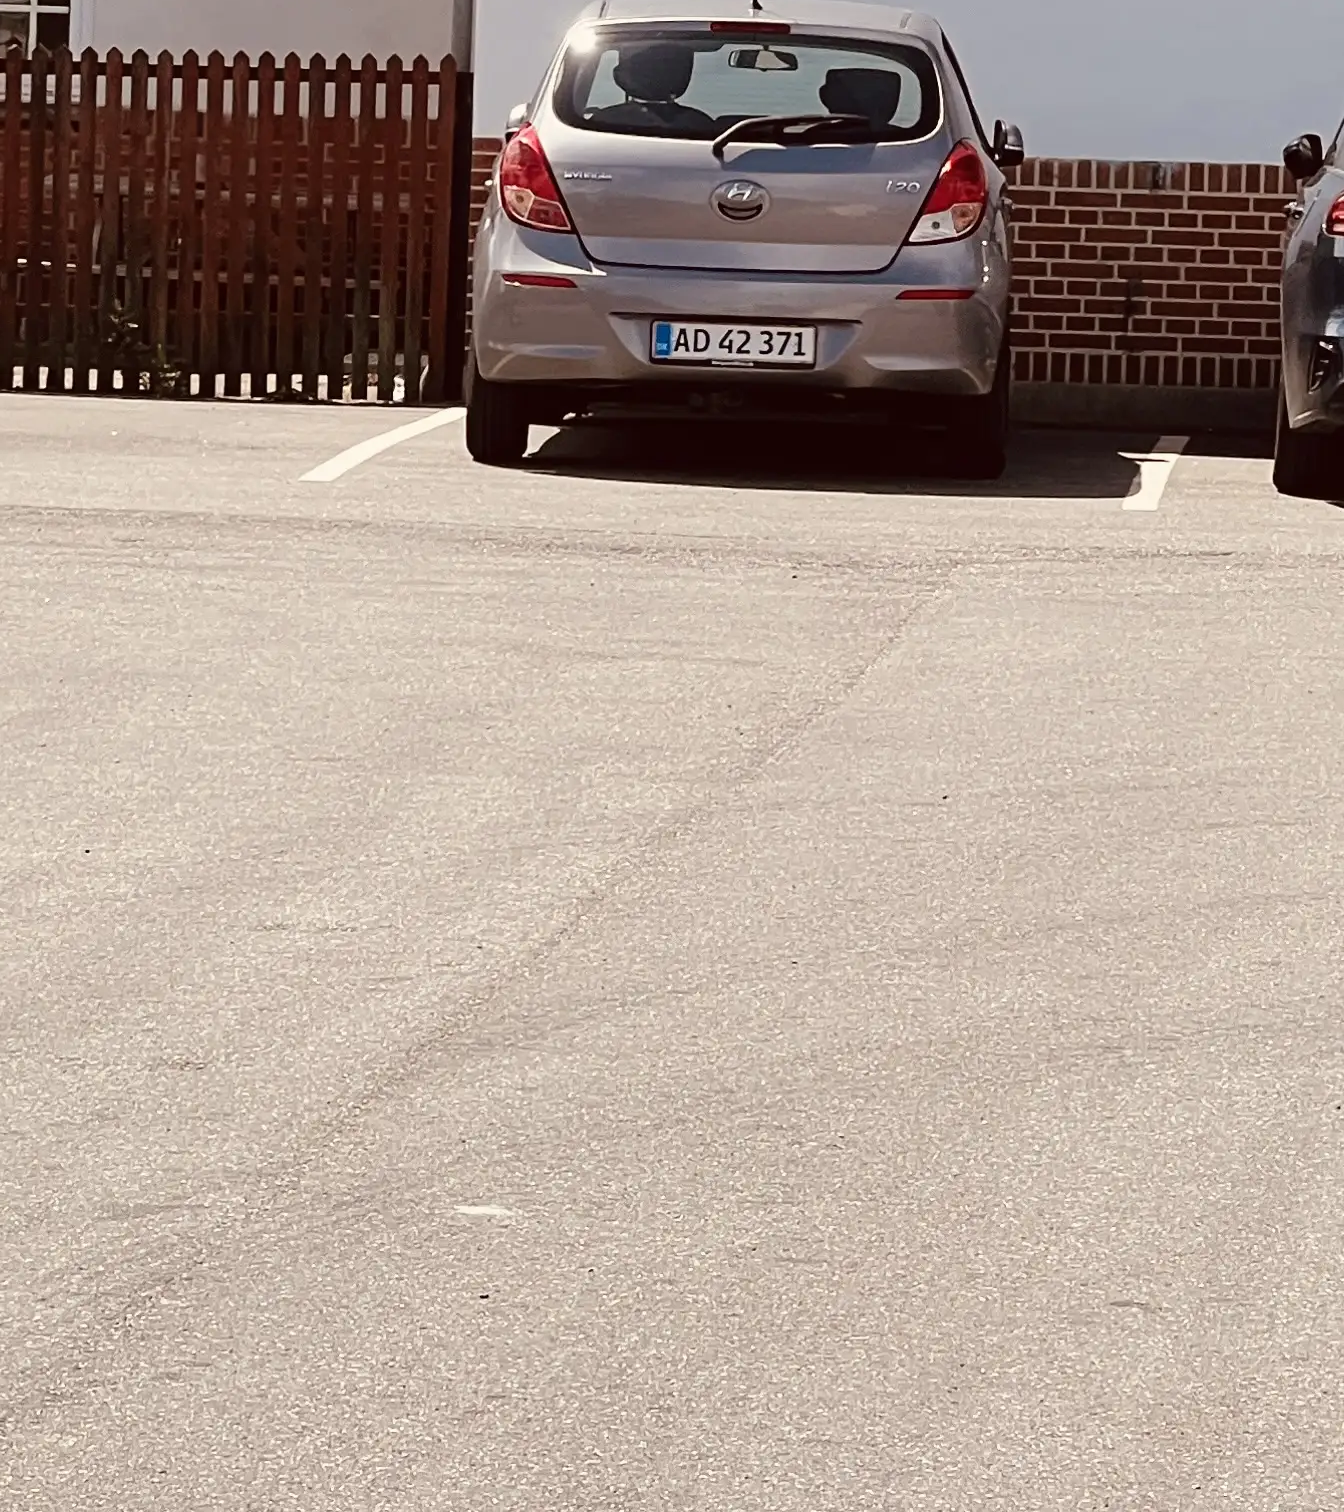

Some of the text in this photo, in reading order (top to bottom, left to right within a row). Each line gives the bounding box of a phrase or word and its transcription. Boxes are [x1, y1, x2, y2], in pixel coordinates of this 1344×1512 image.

[673, 328, 711, 353] AD
[718, 329, 751, 355] 42
[758, 330, 806, 356] 371
